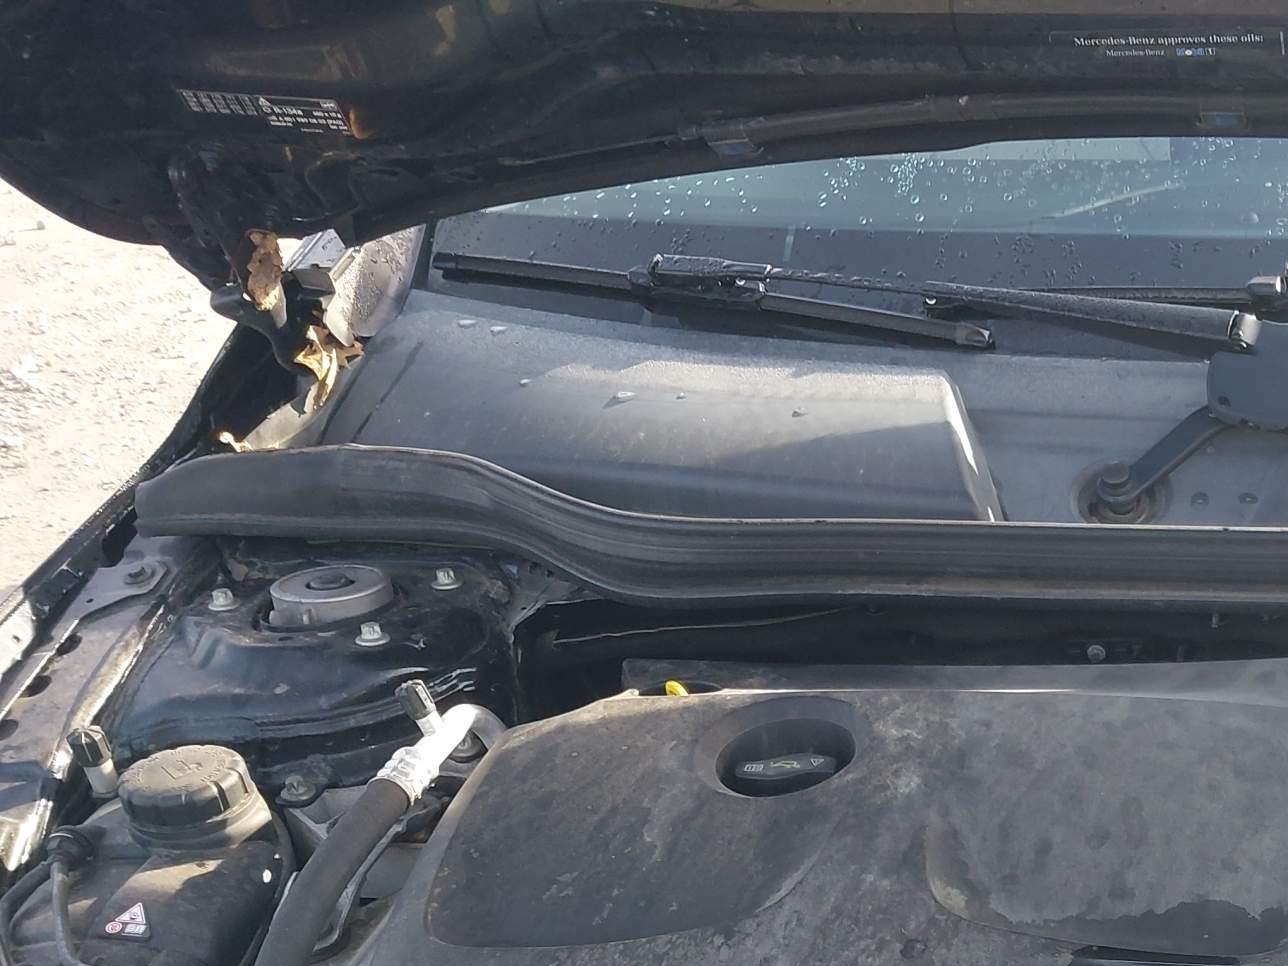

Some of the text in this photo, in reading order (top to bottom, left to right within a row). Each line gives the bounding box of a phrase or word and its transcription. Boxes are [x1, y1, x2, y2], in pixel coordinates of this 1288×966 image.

[1073, 33, 1264, 47] Mercedes-Benz approves these oils:
[1106, 49, 1165, 57] Mercedes-Benz
